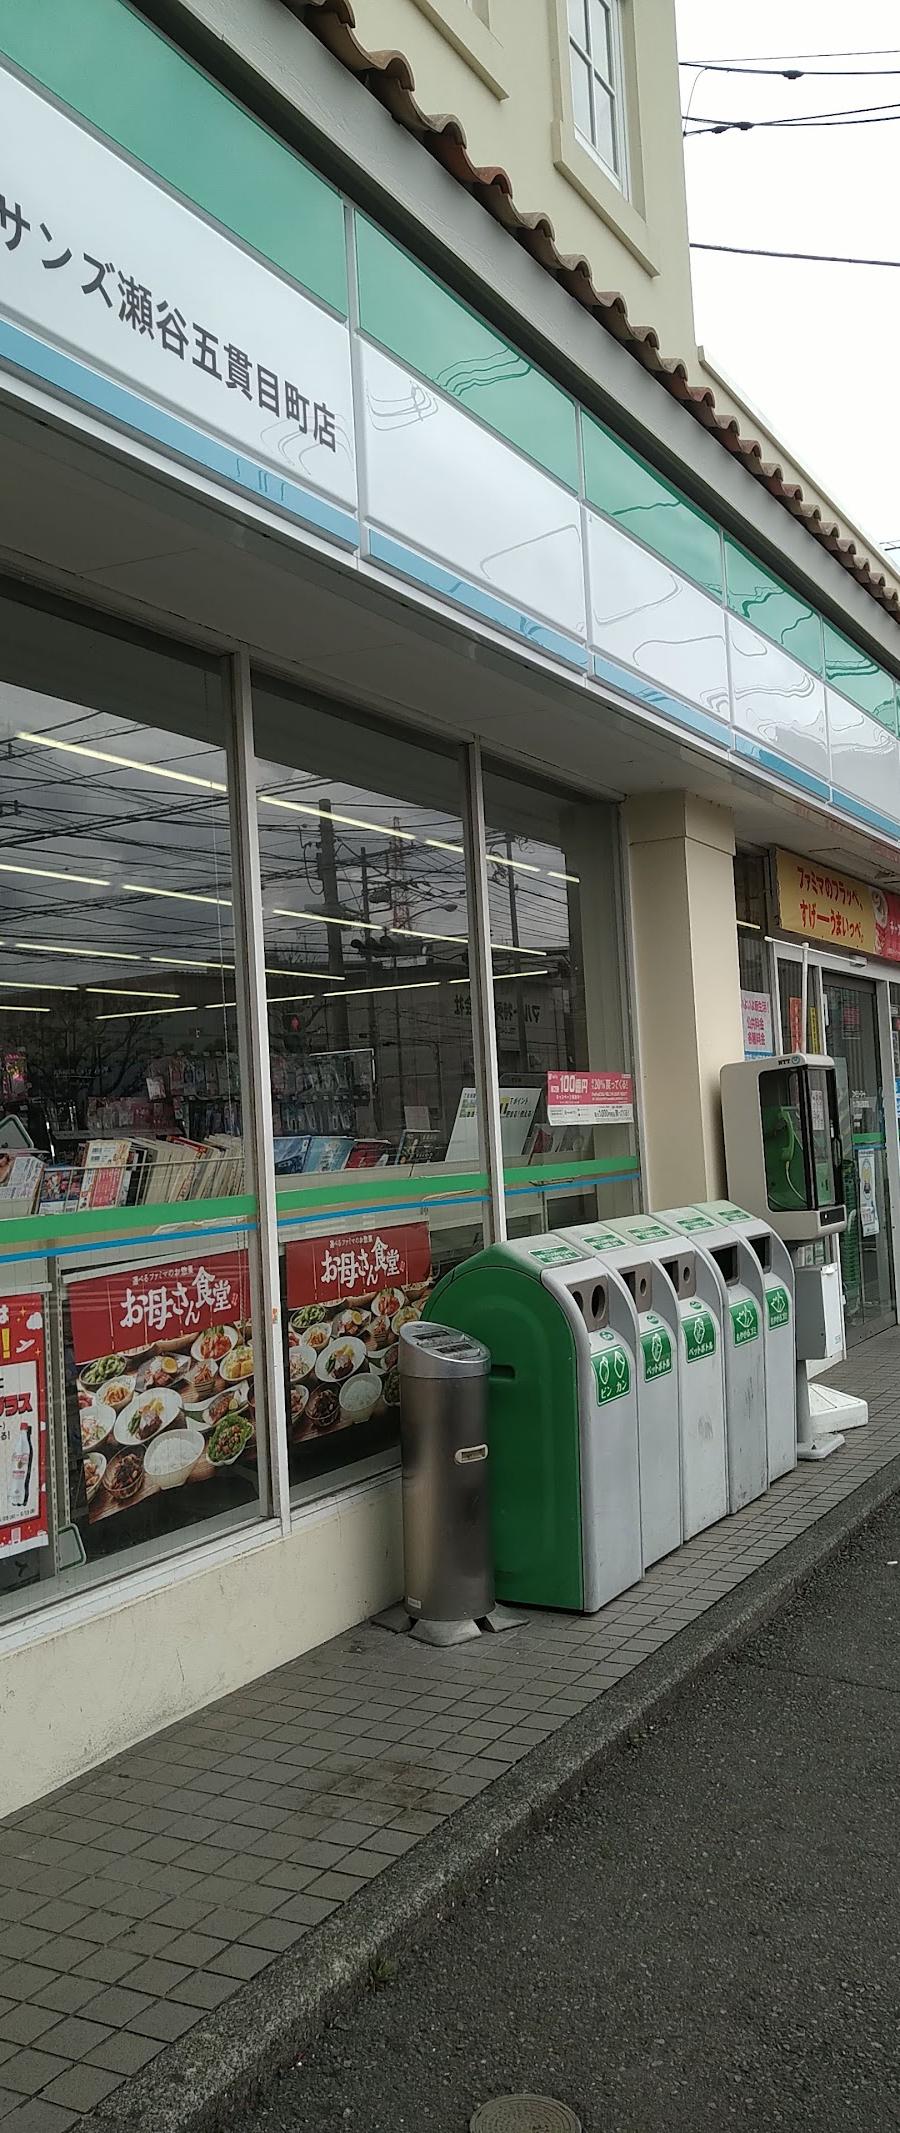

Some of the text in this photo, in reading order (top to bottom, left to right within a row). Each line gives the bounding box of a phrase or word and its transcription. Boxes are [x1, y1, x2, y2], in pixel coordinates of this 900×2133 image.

[0, 193, 338, 453] サンズ瀬谷五貫目町店
[778, 1058, 791, 1066] NTT
[320, 1236, 401, 1289] お母さん食堂
[119, 1266, 233, 1331] お母さん食堂
[688, 1343, 713, 1356] ペットボトル
[646, 1360, 671, 1375] ペットボトル
[600, 1380, 628, 1399] ビン カン
